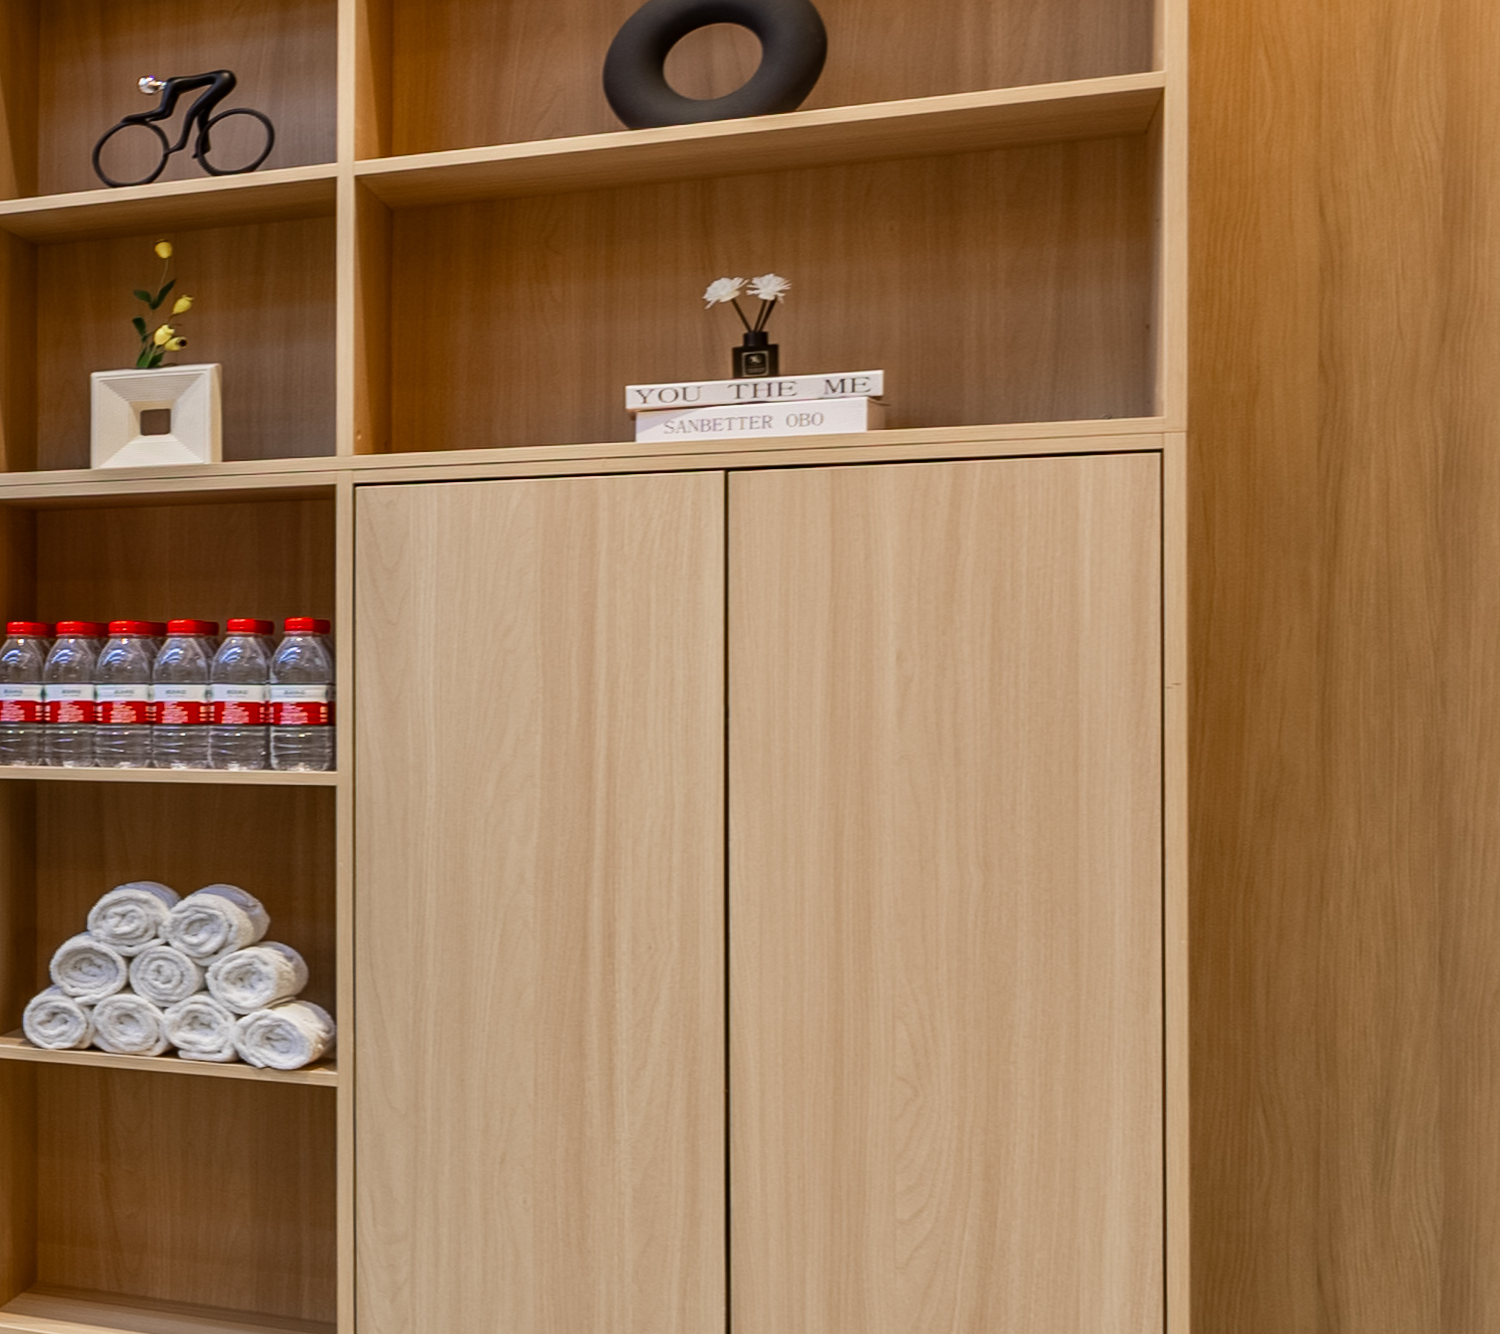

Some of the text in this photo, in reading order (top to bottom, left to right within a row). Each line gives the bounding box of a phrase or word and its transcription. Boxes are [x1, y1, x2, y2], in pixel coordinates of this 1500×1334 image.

[635, 375, 872, 406] YOU THE ME
[663, 411, 825, 435] SANBETTER OBO
